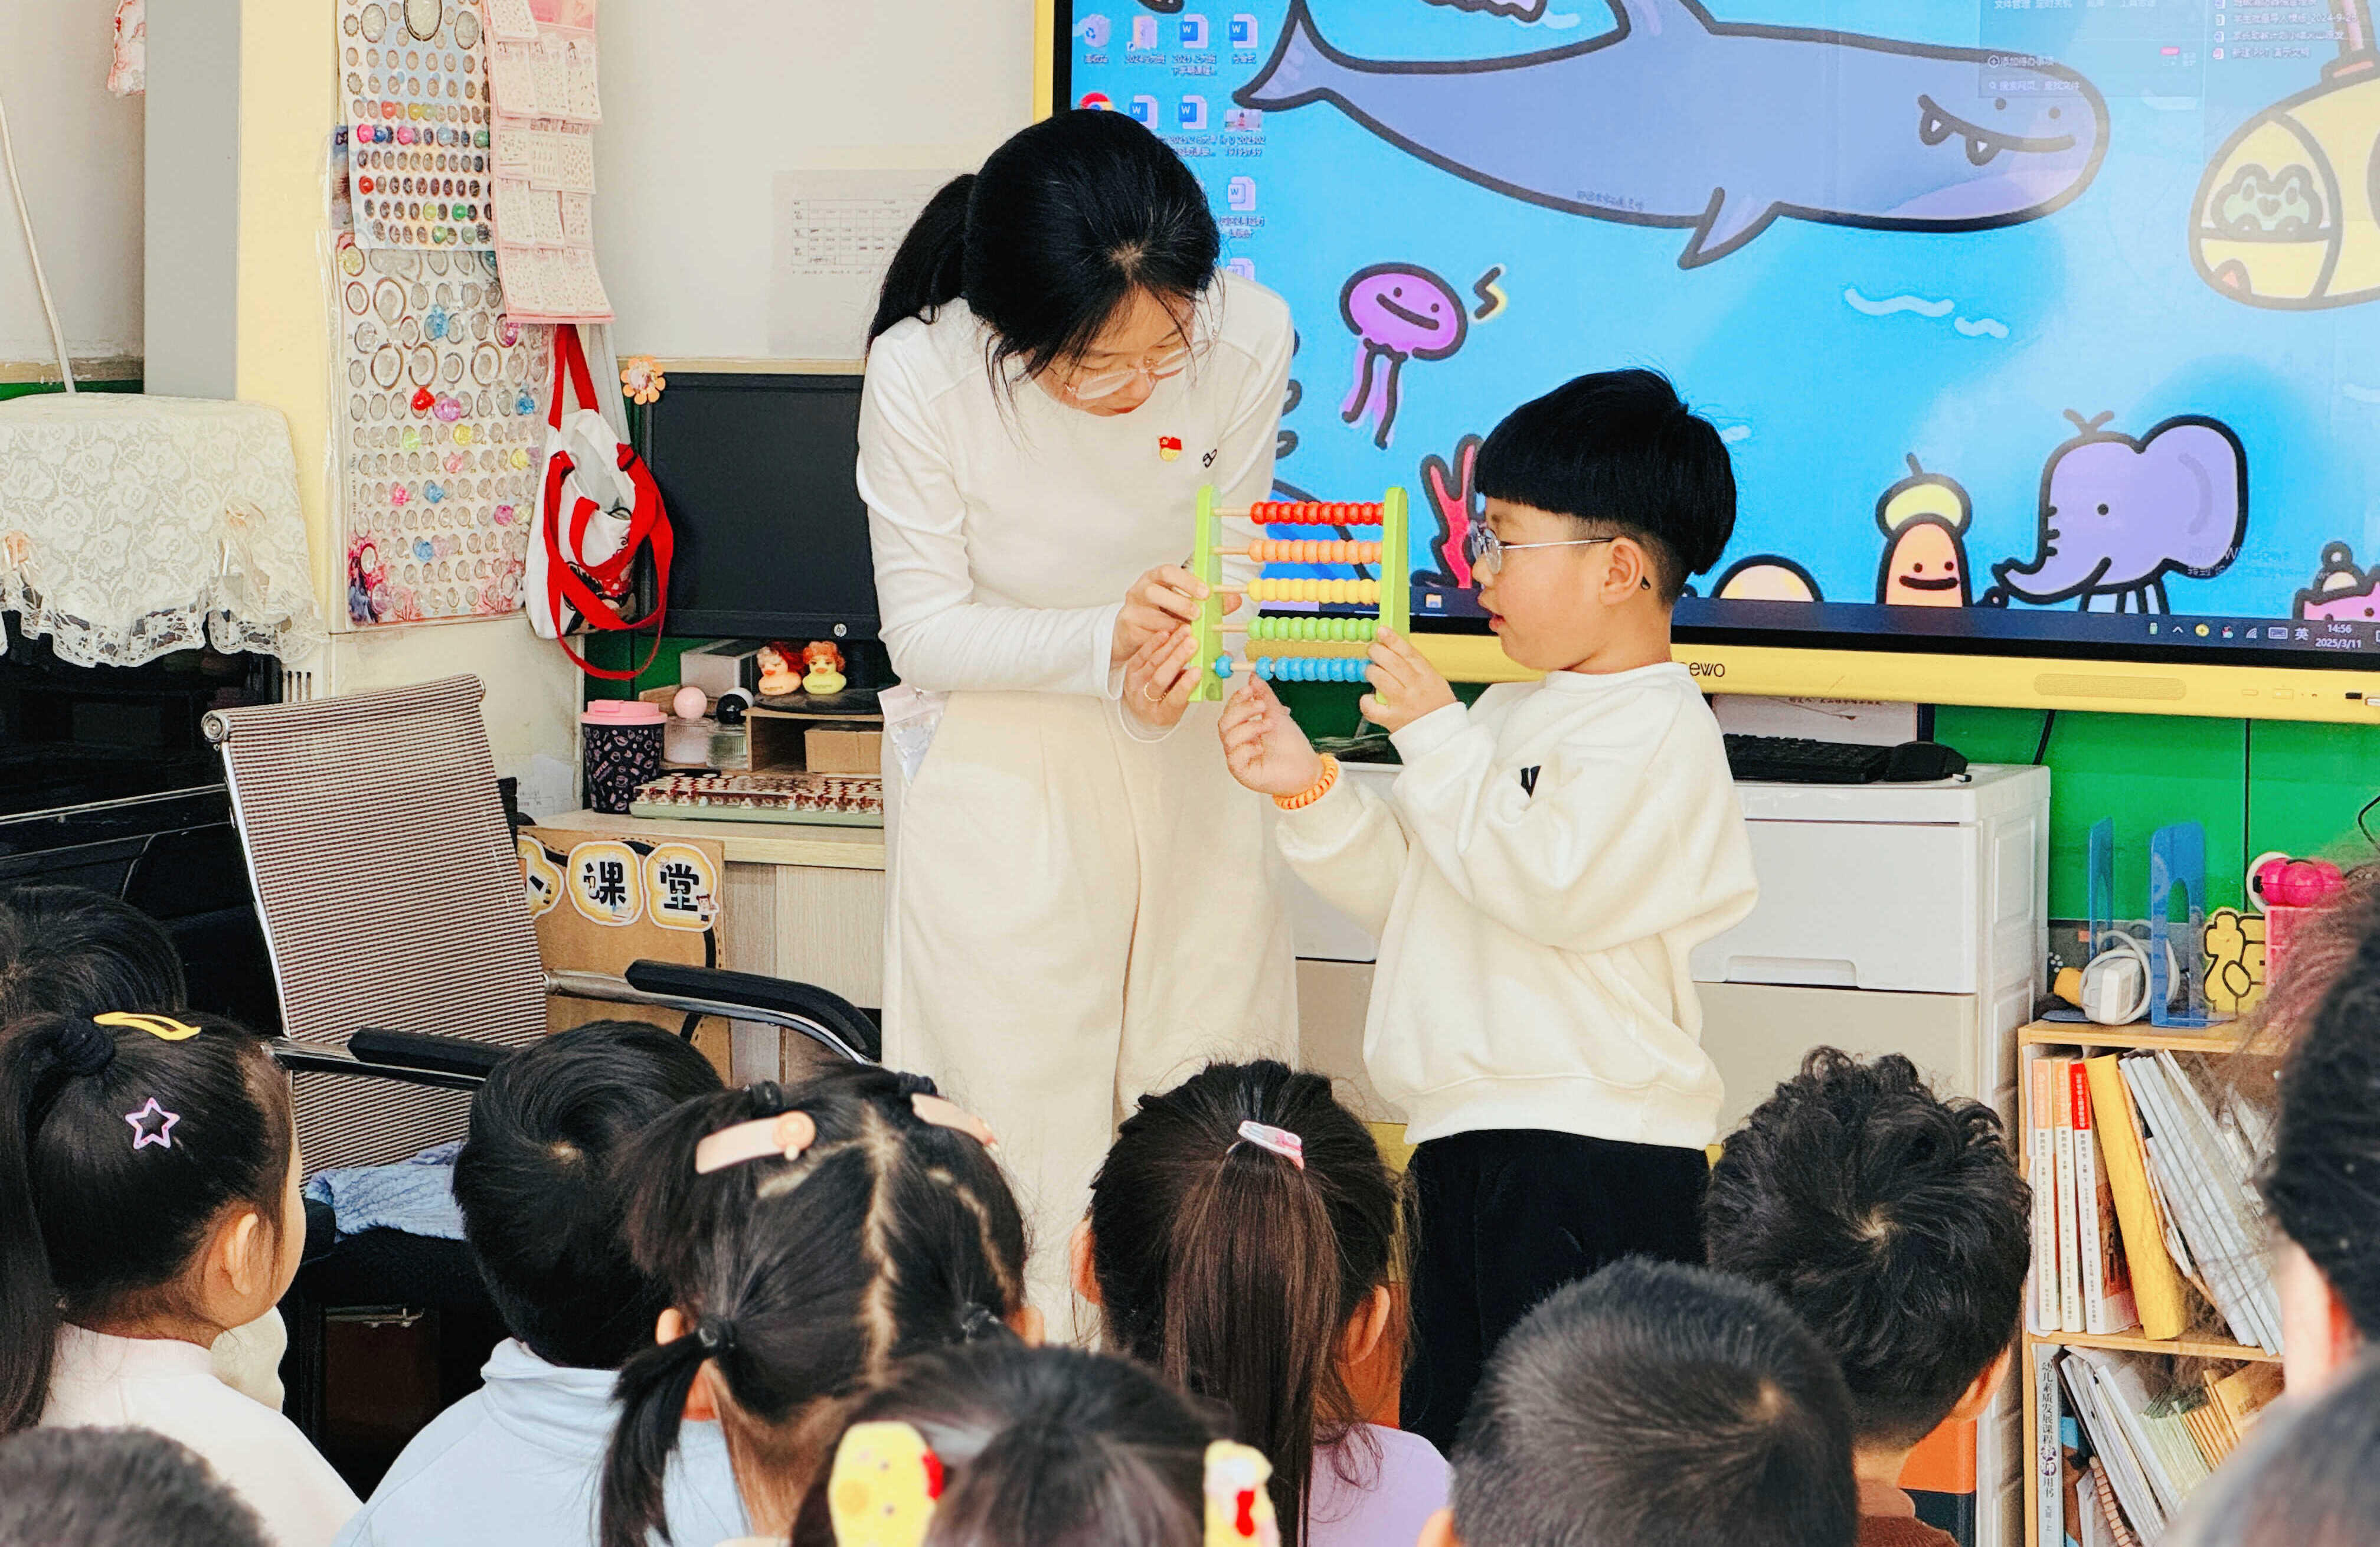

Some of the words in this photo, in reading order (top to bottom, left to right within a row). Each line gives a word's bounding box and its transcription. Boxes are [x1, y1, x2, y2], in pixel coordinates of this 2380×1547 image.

[1182, 25, 1191, 34] W
[1232, 25, 1241, 34] W
[1132, 106, 1140, 115] W
[1181, 106, 1189, 115] W
[2327, 623, 2352, 634] 14:56
[2294, 628, 2309, 641] 英
[2315, 637, 2362, 649] 2025/3/11
[1681, 662, 1725, 677] ewo
